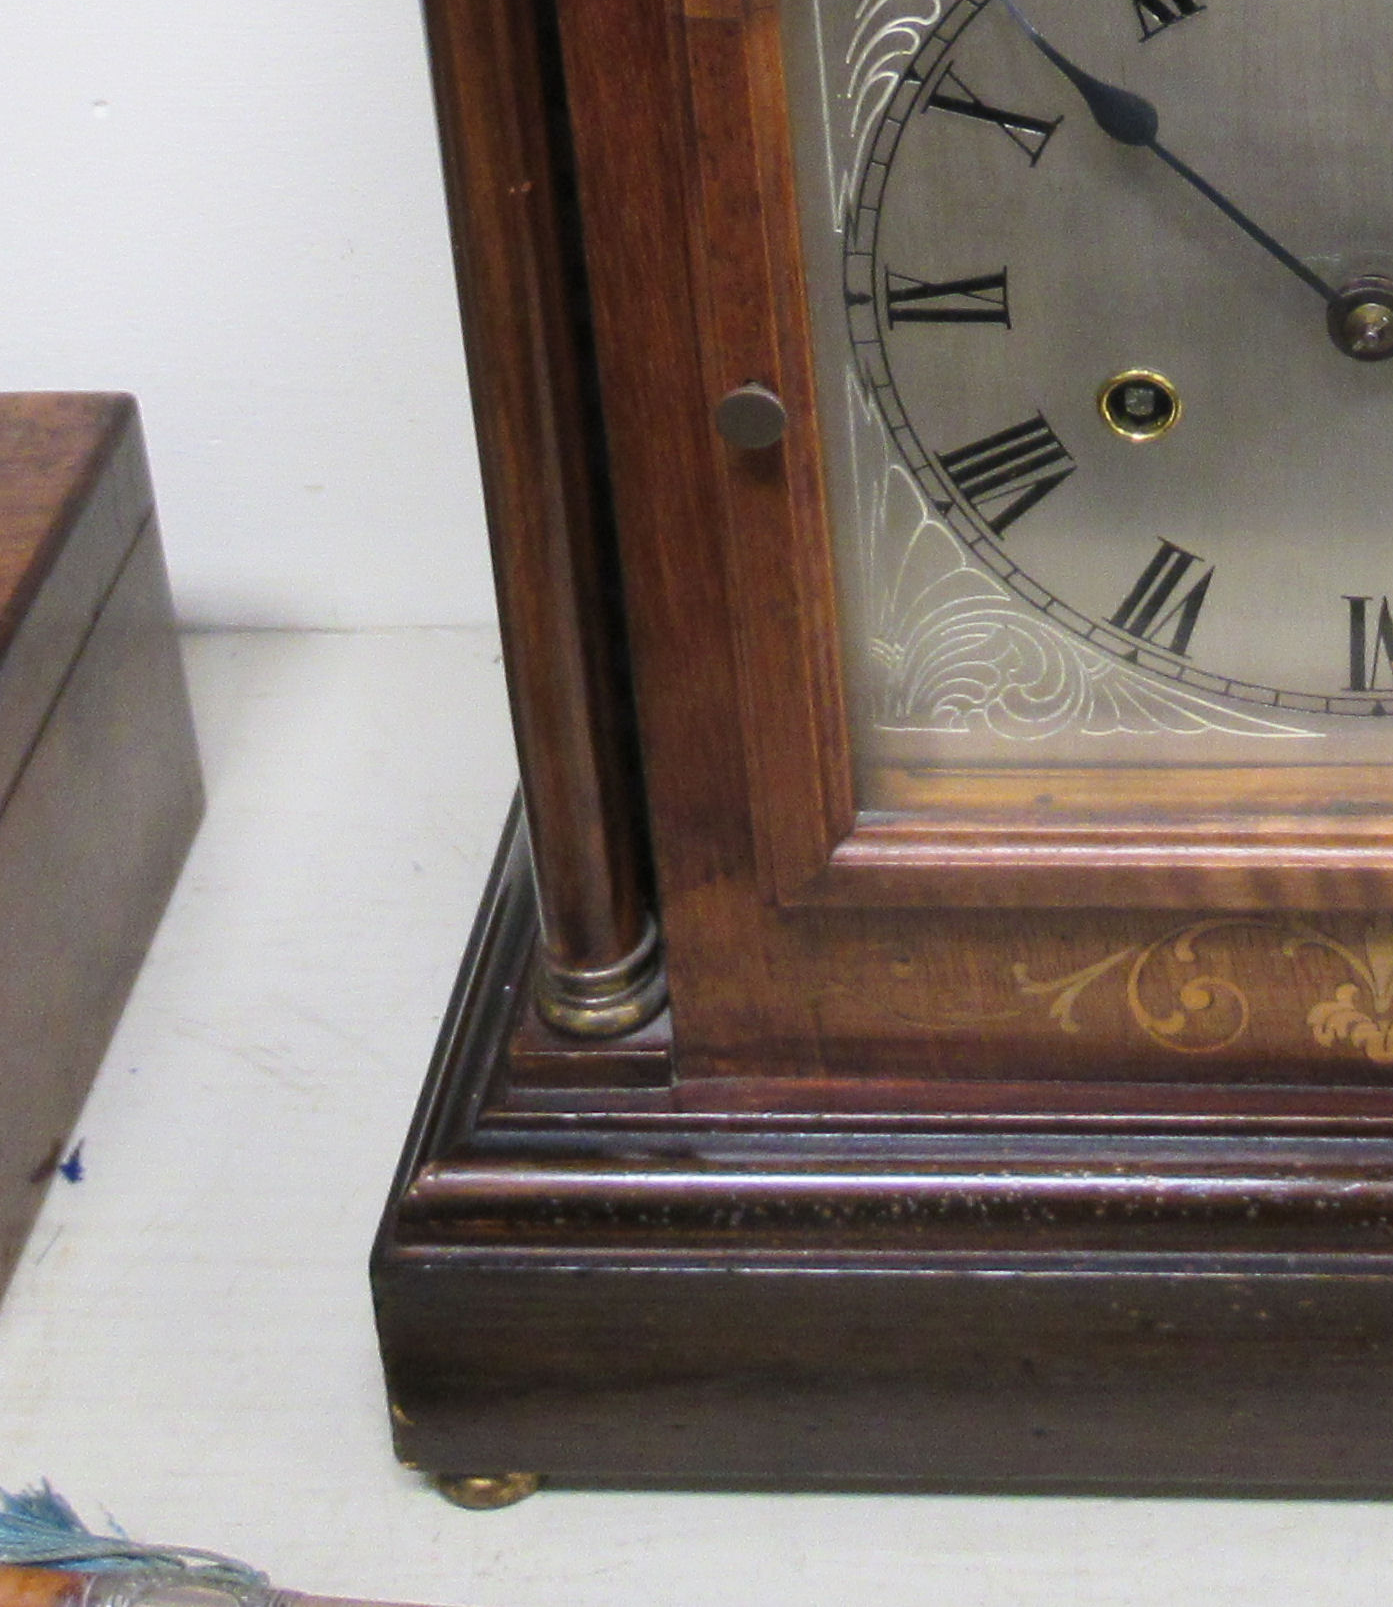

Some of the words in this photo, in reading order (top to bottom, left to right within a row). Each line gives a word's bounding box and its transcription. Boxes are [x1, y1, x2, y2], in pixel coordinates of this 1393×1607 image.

[922, 60, 1064, 167] X
[884, 264, 1011, 330] IX
[935, 410, 1077, 541] VIII
[1102, 537, 1218, 660] VII
